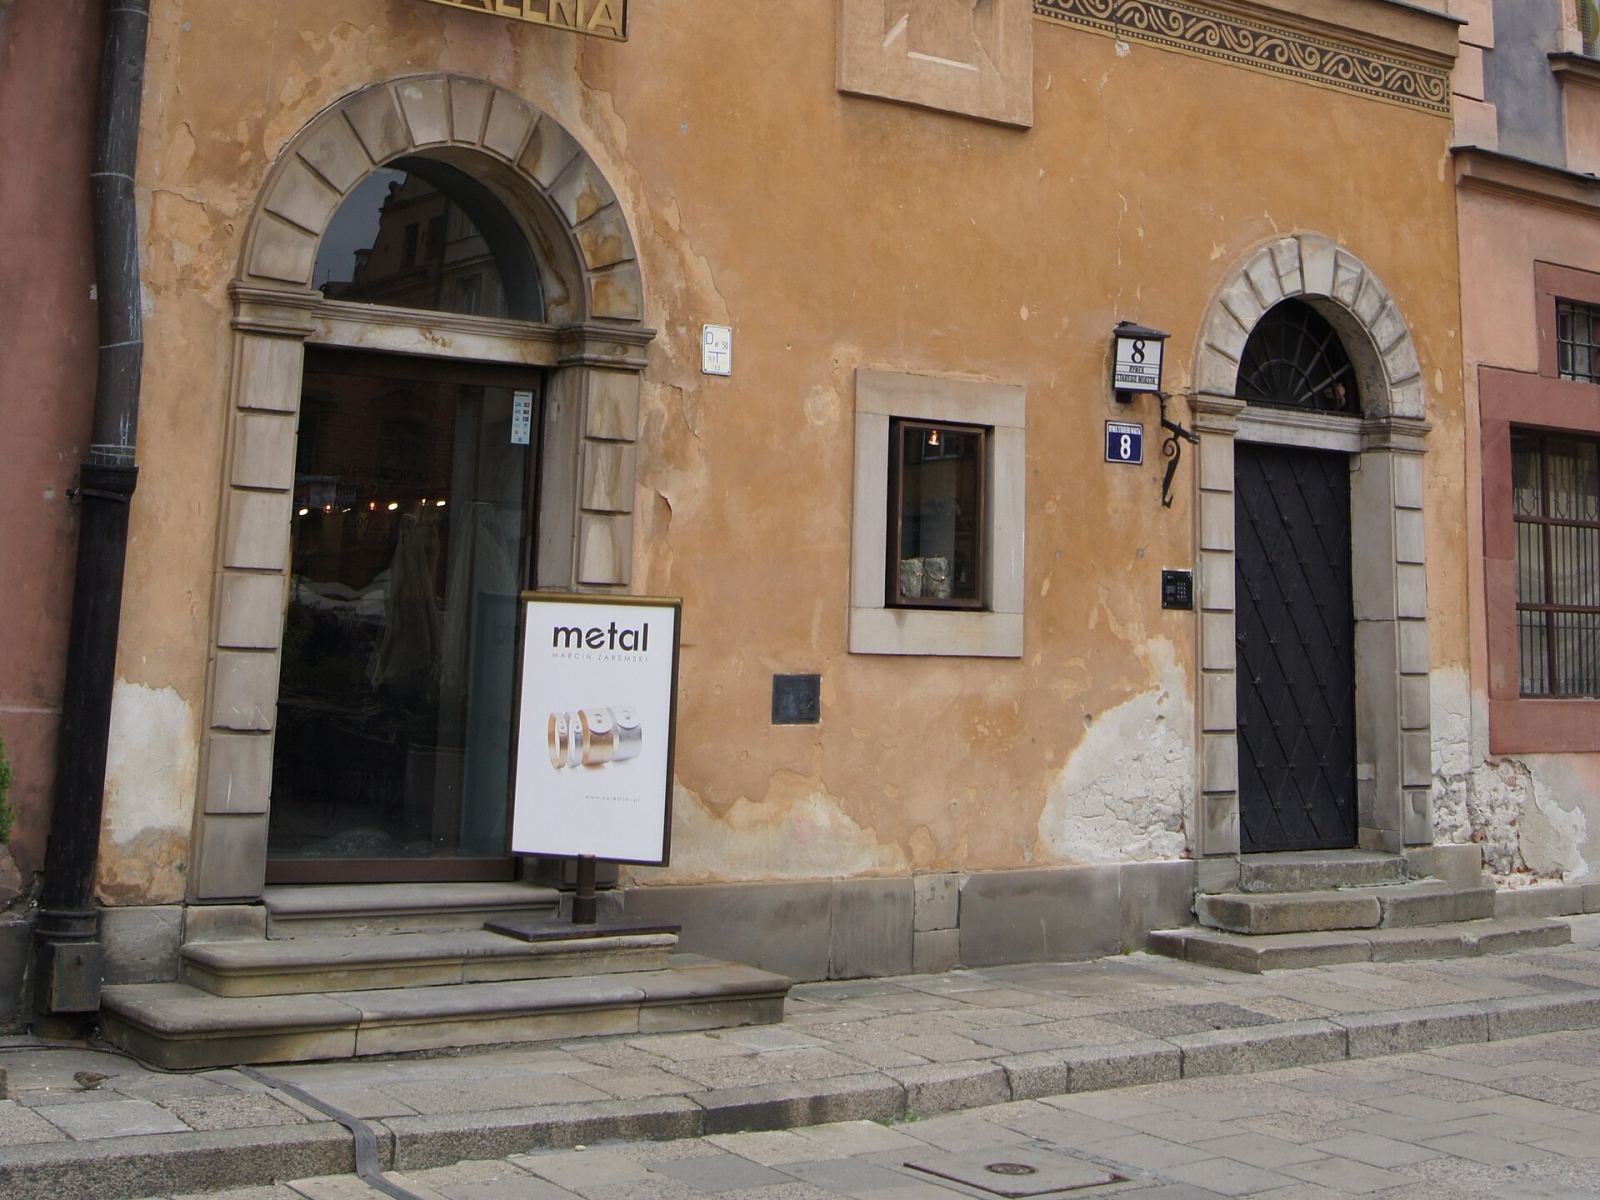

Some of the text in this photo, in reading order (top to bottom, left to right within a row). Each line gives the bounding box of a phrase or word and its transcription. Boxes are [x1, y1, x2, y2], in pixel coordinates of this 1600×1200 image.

[1131, 340, 1145, 364] 8
[1120, 434, 1131, 459] 8
[553, 622, 648, 651] metal
[552, 652, 592, 660] MARCIN
